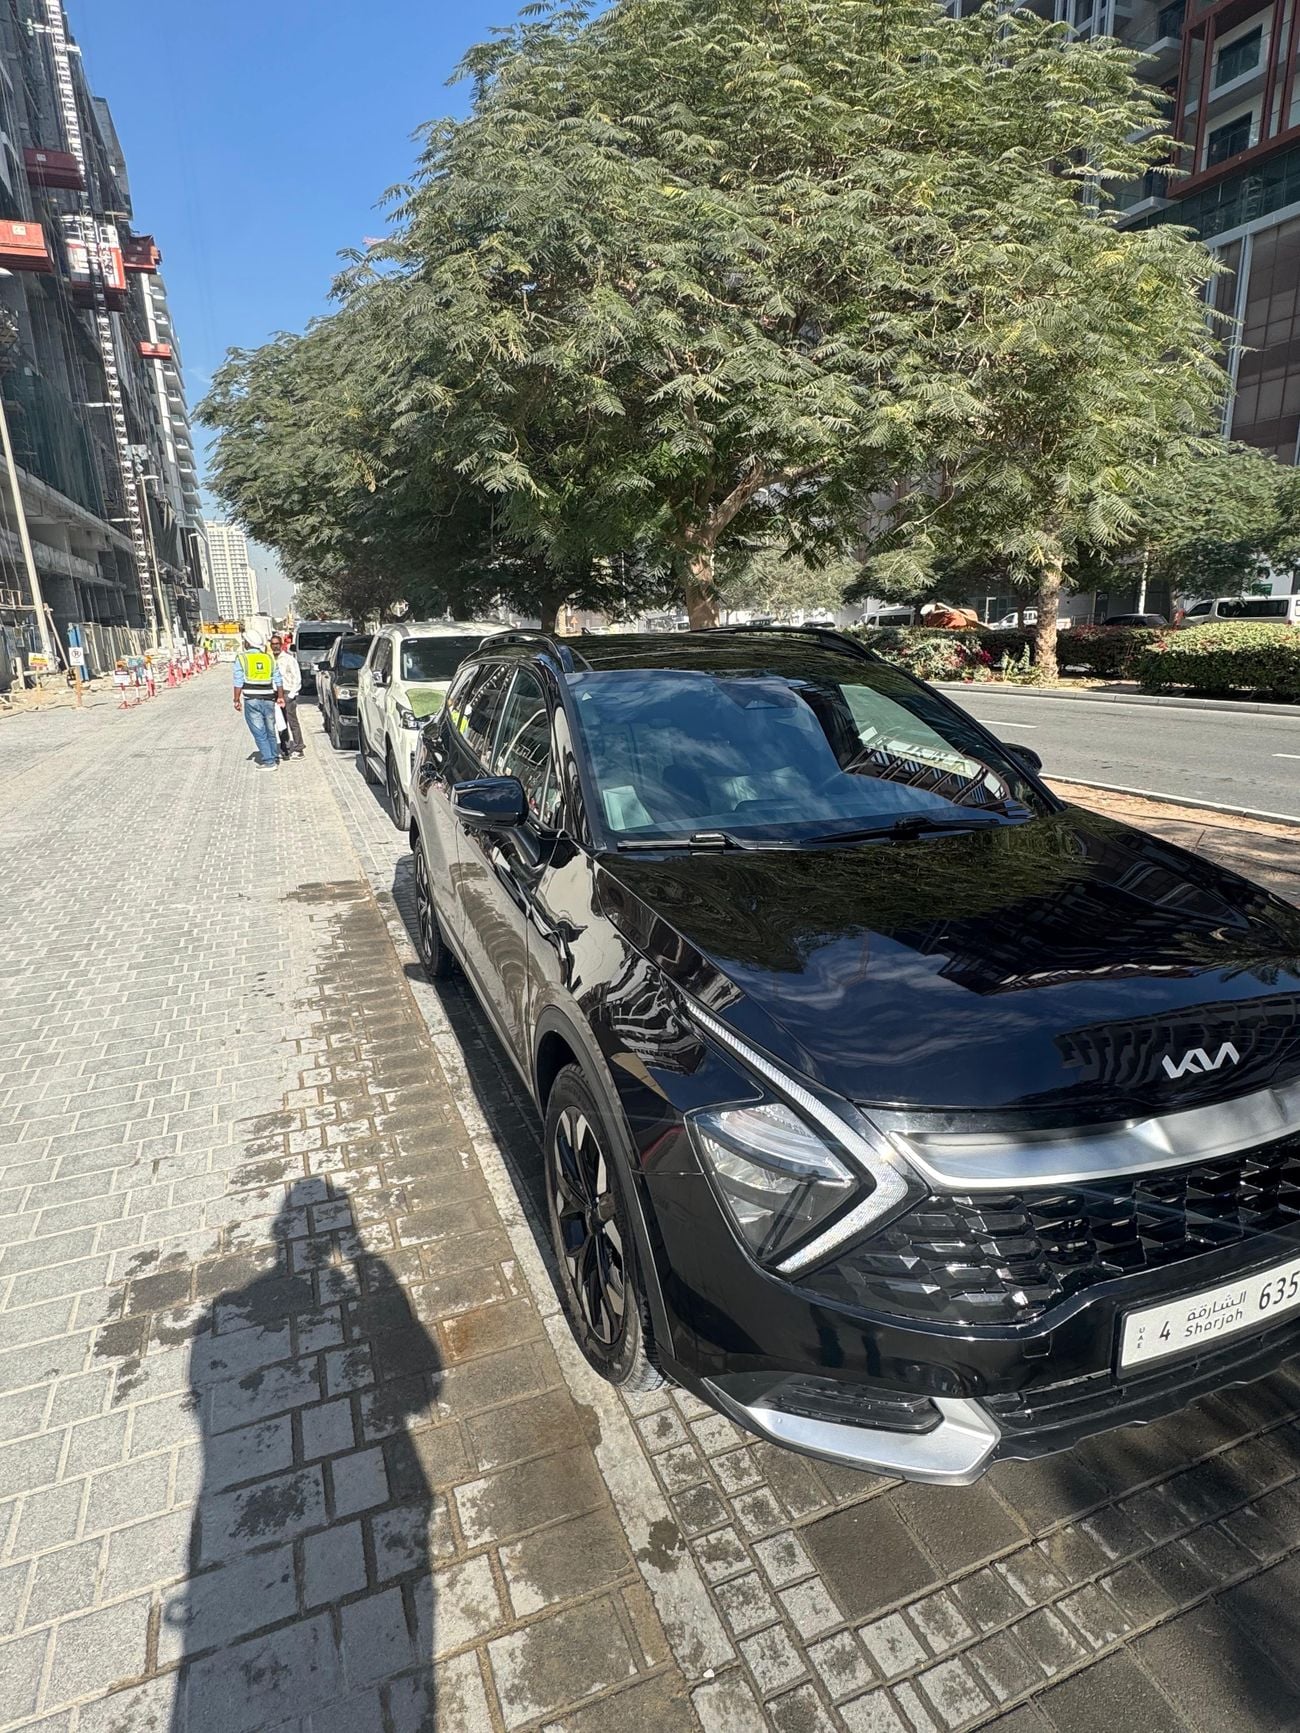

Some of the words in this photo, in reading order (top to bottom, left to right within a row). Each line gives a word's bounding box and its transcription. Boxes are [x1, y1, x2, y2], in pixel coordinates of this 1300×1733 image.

[1187, 1290, 1247, 1322] الشارقة
[1259, 1271, 1300, 1311] 635
[1137, 1327, 1146, 1349] UAE
[1159, 1320, 1171, 1341] 4
[1184, 1308, 1243, 1338] Sharjah
